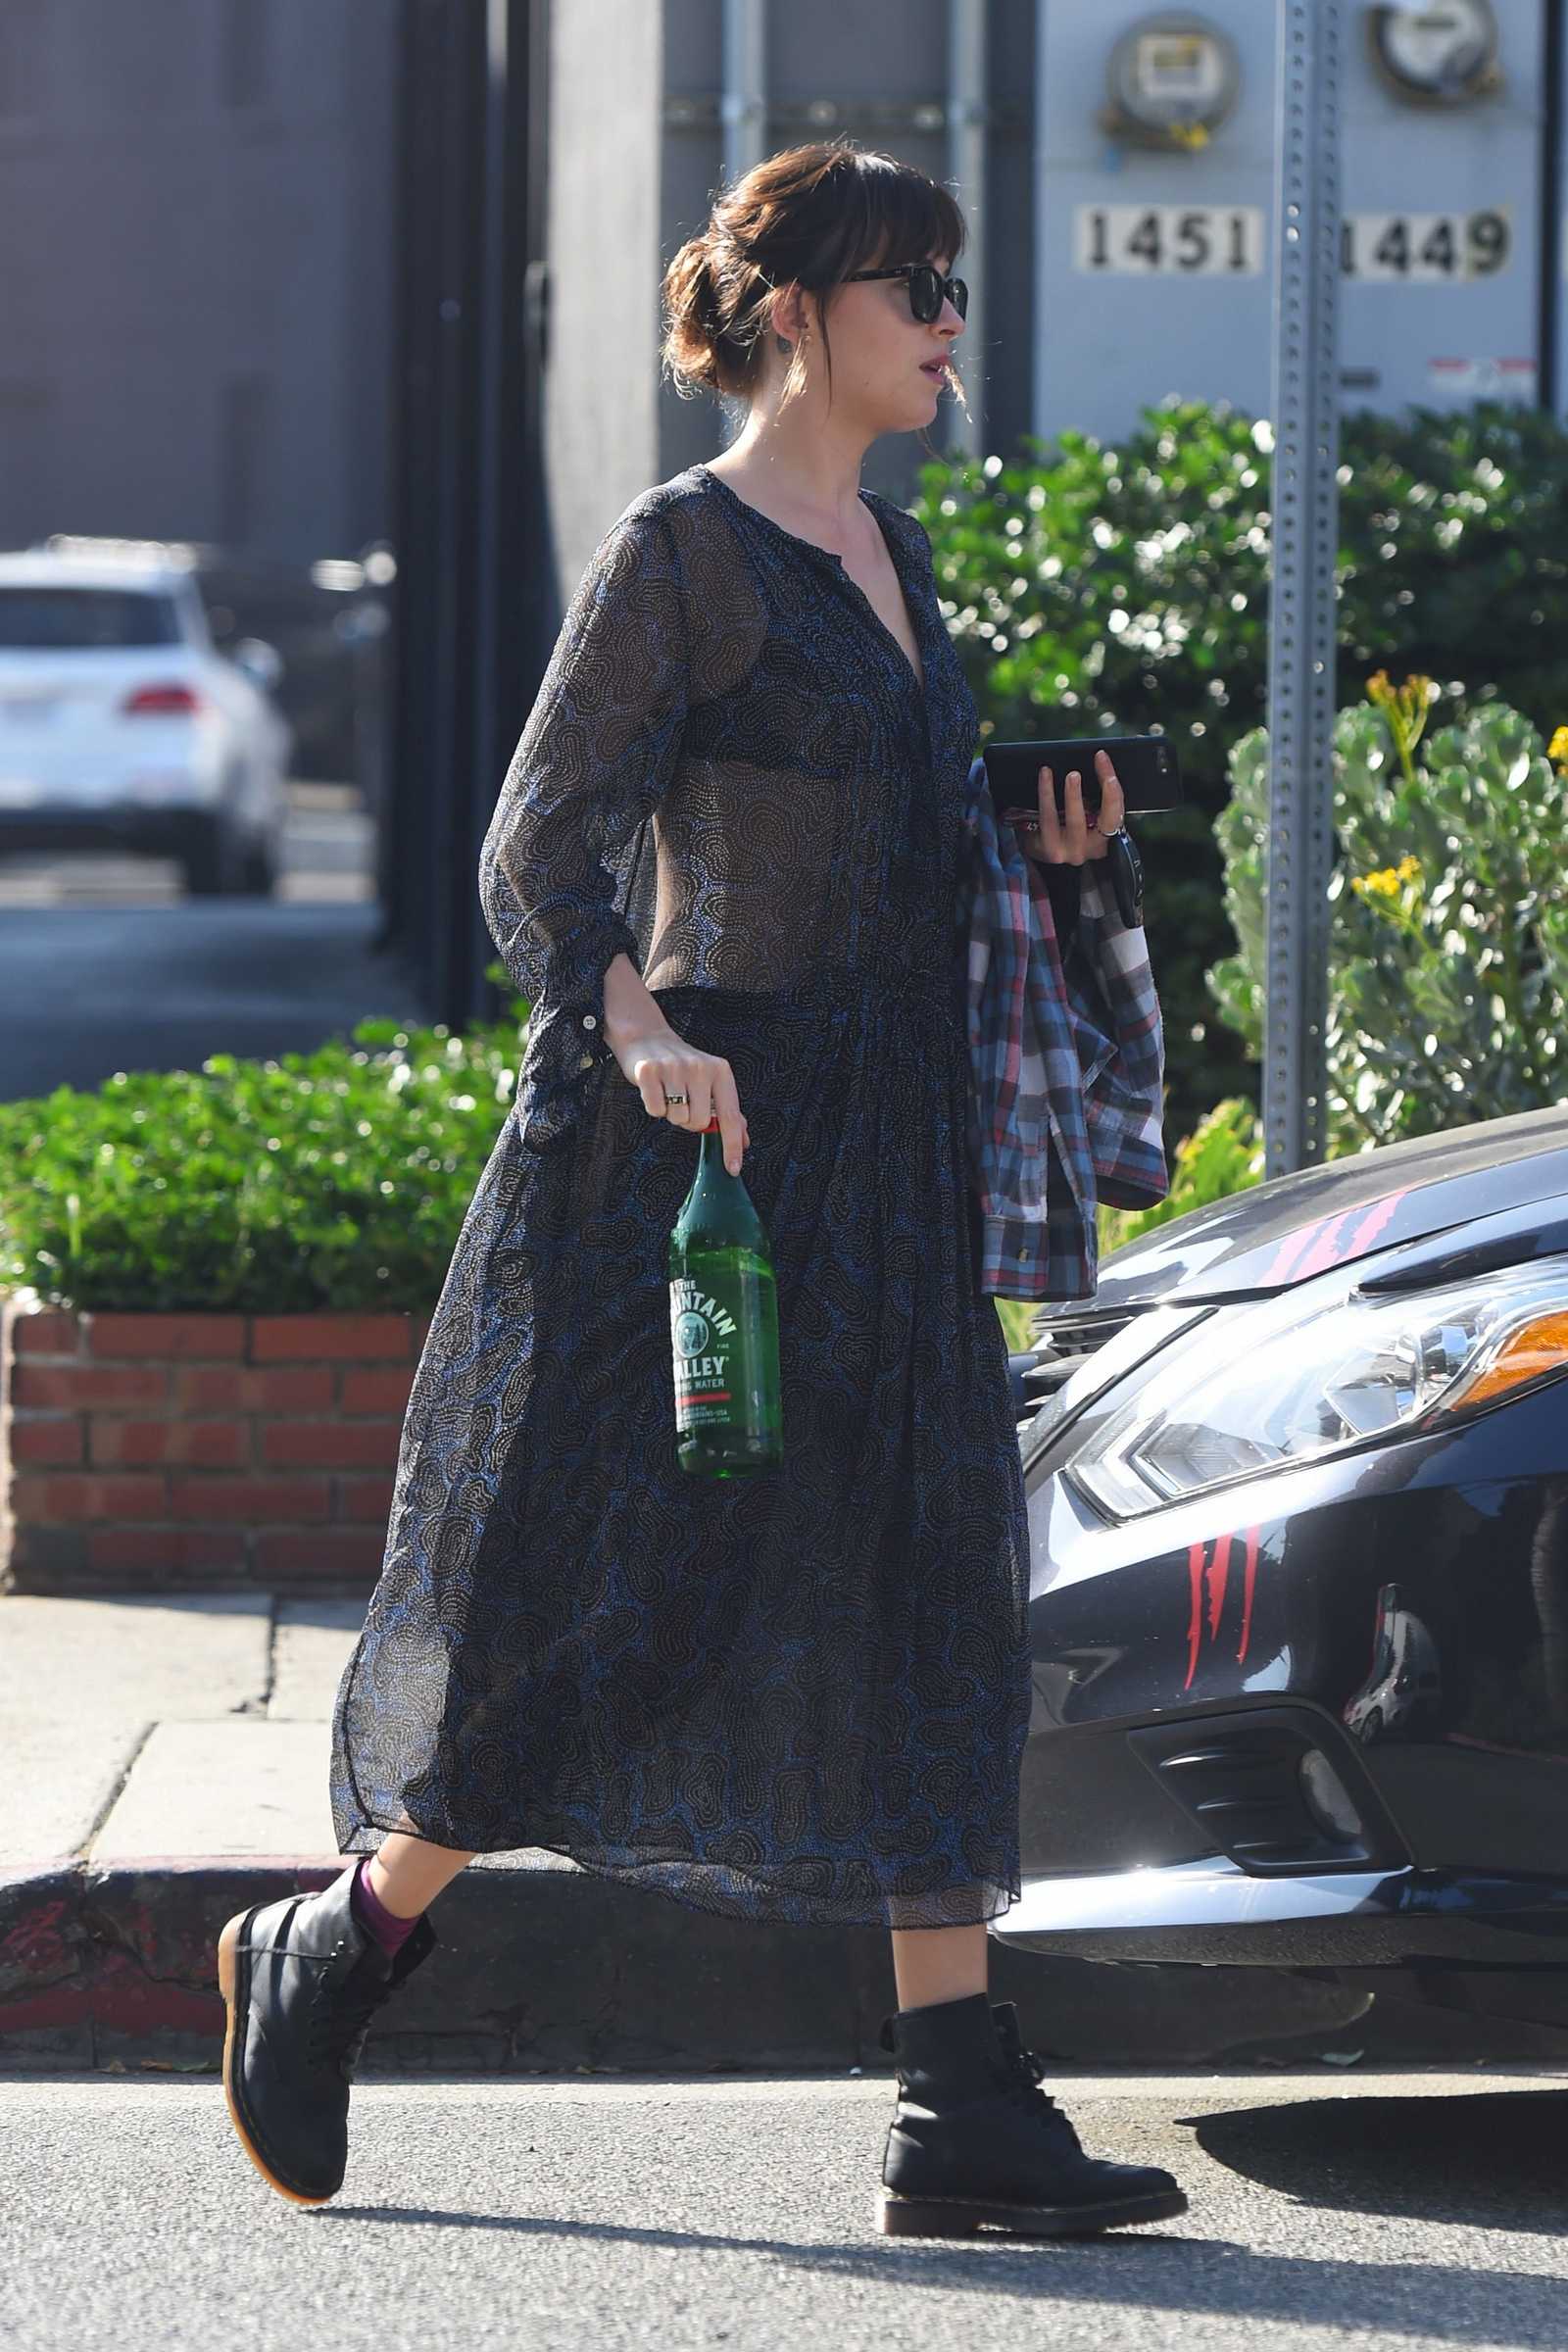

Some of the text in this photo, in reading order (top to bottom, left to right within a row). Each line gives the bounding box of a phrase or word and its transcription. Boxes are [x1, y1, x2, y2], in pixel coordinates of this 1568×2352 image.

[1088, 210, 1250, 270] 1451
[1340, 212, 1511, 277] 1449
[679, 1280, 696, 1291] THE
[695, 1379, 724, 1389] WATER
